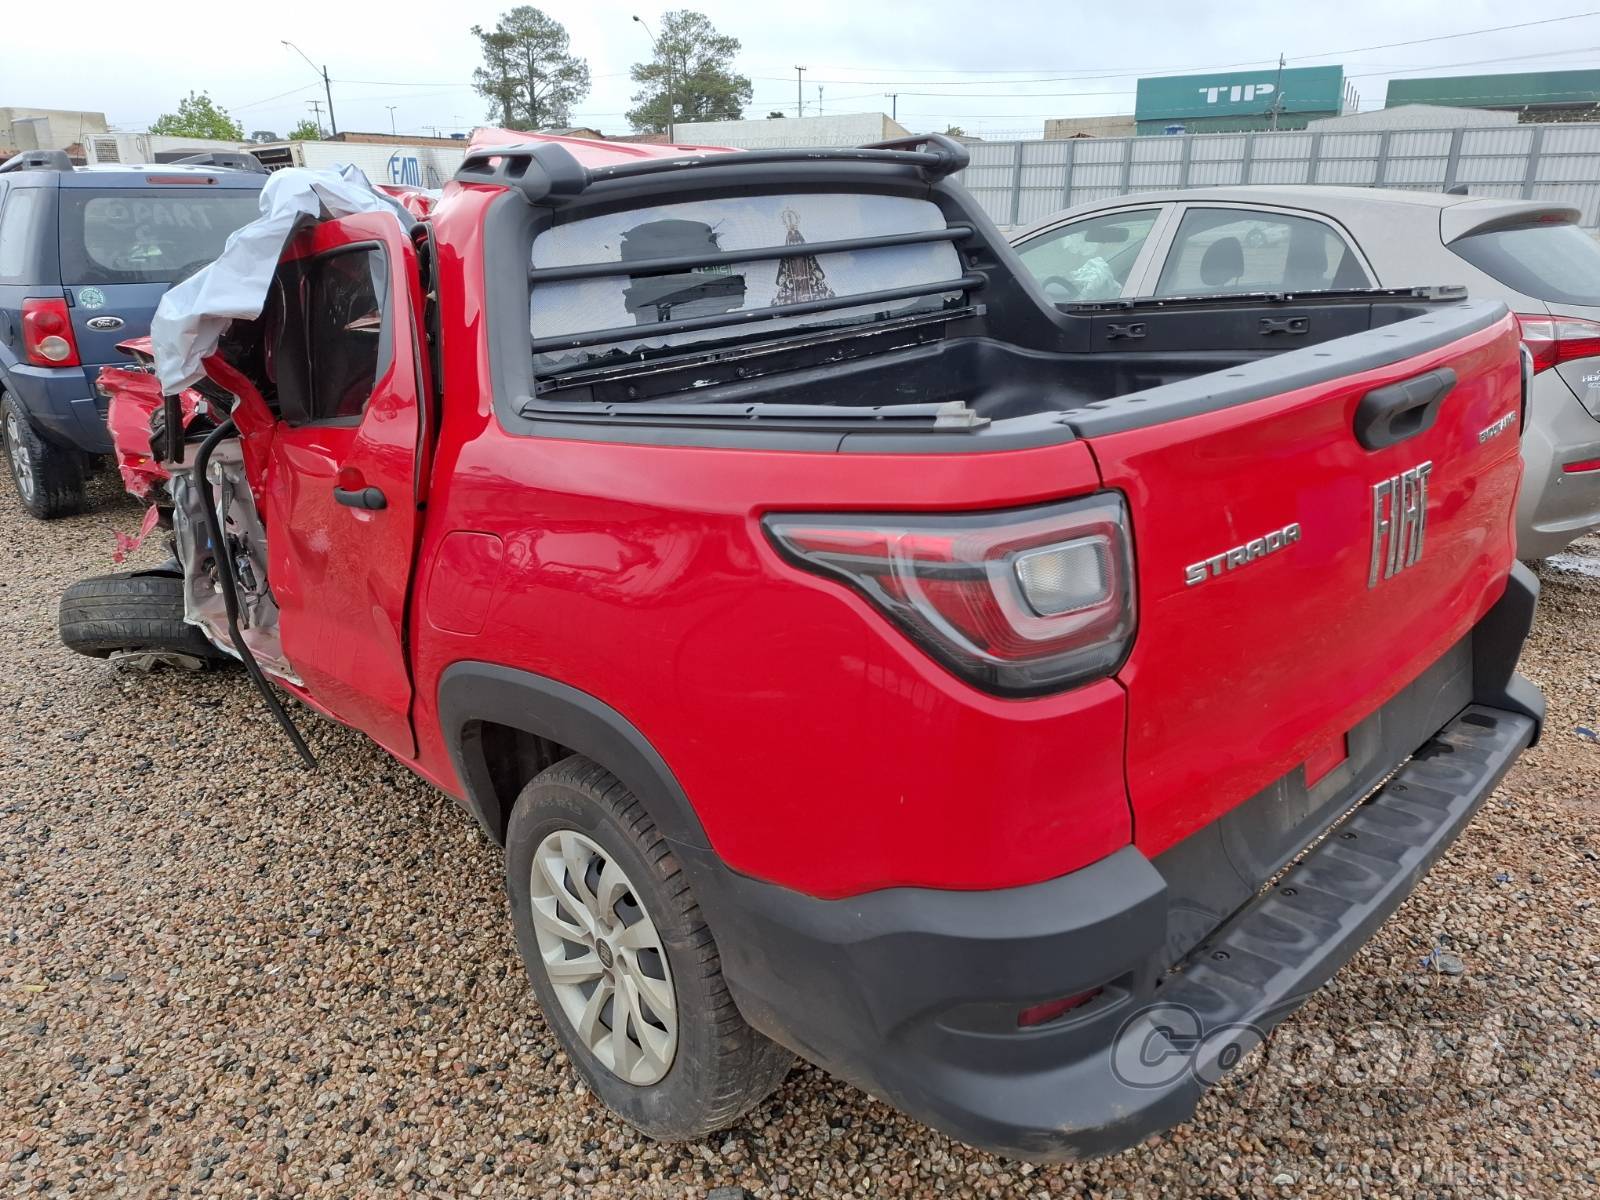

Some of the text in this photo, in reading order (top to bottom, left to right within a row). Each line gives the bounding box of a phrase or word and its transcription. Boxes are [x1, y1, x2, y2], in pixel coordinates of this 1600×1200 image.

[1198, 83, 1275, 103] TIP
[1184, 522, 1302, 587] STRADA
[1368, 460, 1433, 590] FIAT
